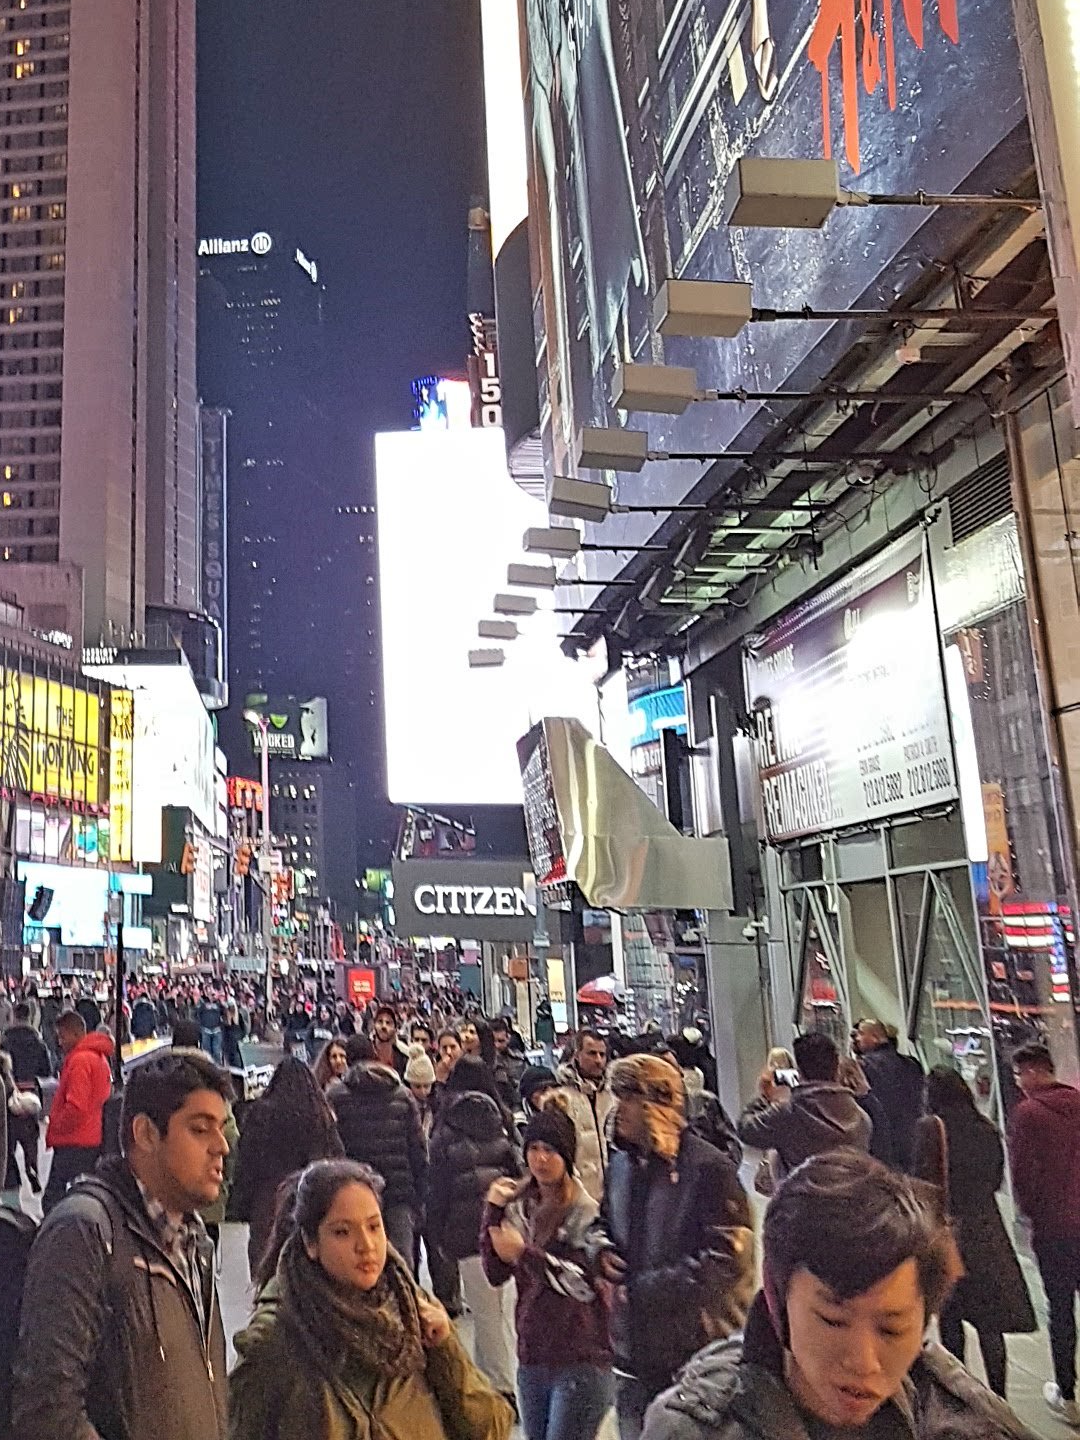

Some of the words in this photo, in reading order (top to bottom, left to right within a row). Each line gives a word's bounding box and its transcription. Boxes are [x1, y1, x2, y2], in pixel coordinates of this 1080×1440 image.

[197, 237, 249, 256] Allianz
[56, 704, 74, 729] THE
[252, 728, 296, 749] WKED
[756, 707, 803, 769] RET
[66, 735, 95, 781] KING
[413, 883, 538, 917] CITIZEN
